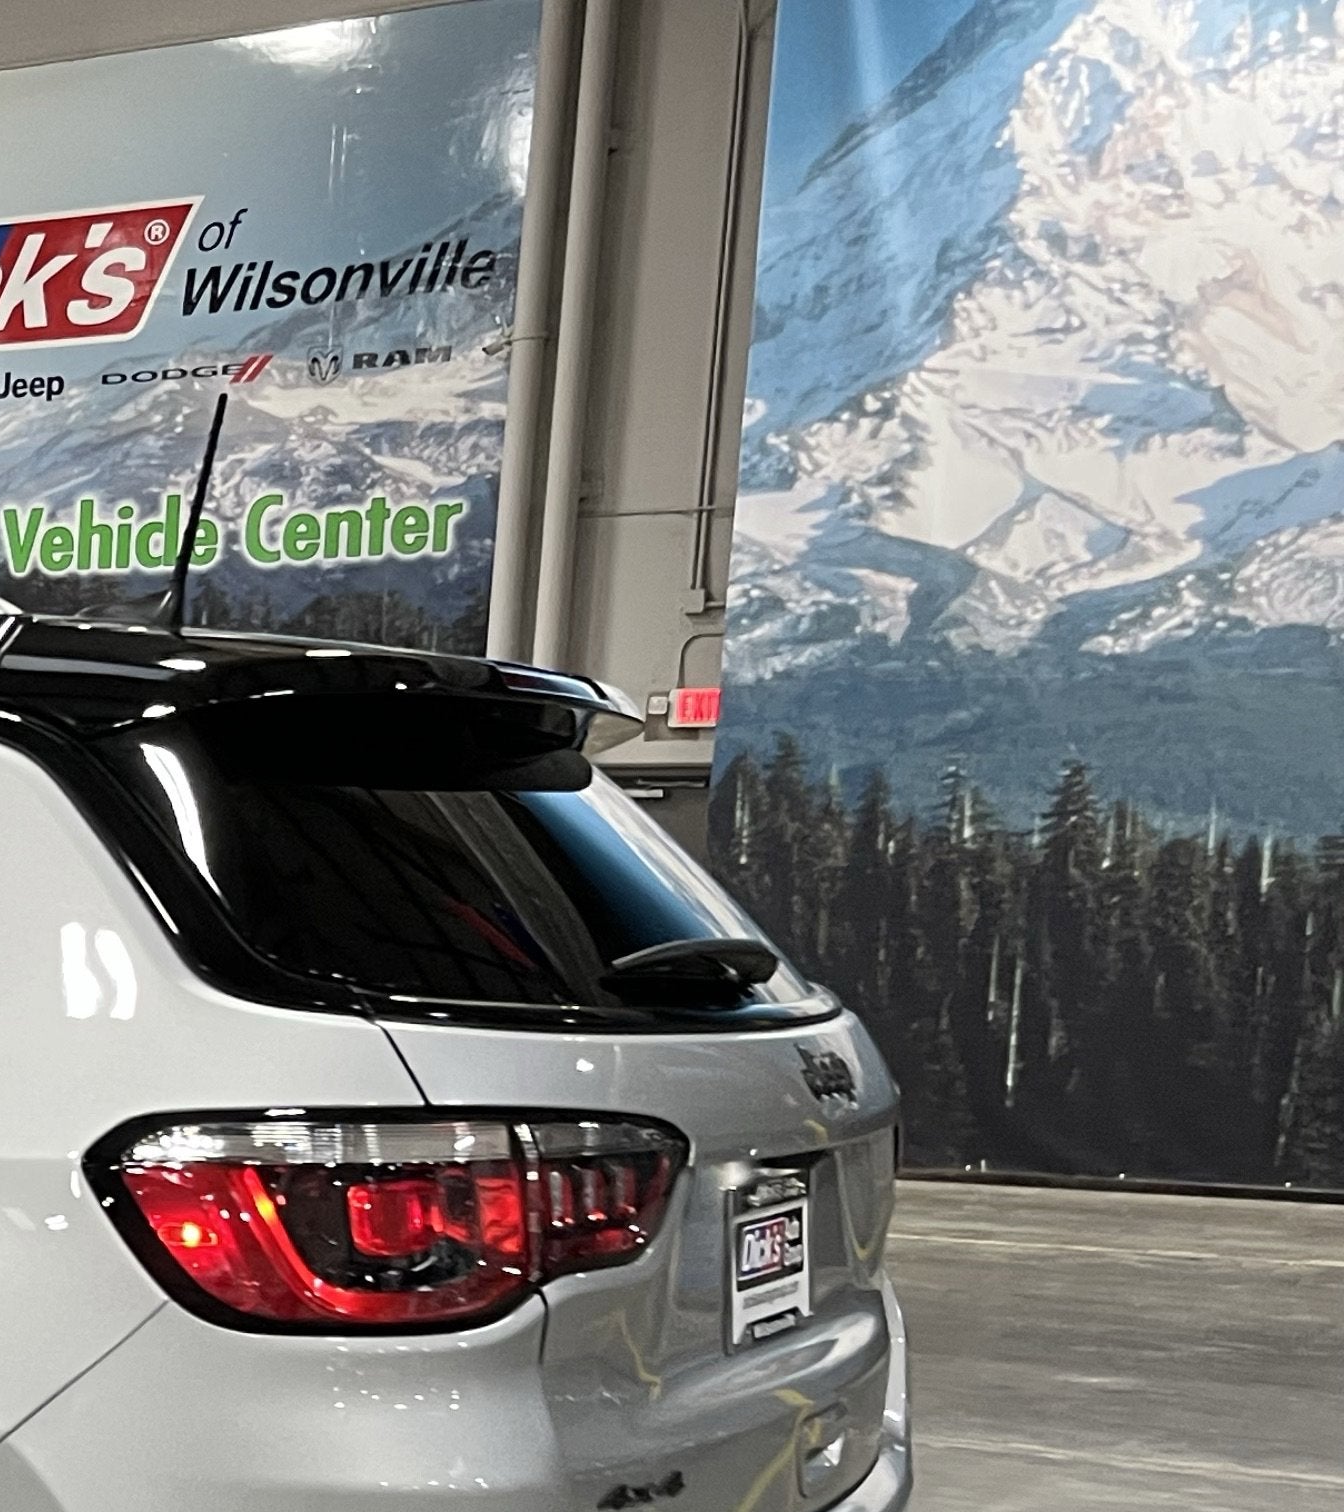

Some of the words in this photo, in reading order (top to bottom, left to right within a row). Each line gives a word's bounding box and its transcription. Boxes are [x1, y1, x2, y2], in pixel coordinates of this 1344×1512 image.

[198, 209, 247, 253] of
[182, 239, 497, 317] Wilsonville
[101, 363, 245, 386] DODGE
[352, 345, 452, 371] RAM
[3, 495, 217, 573] Vehicle
[244, 494, 464, 563] Center
